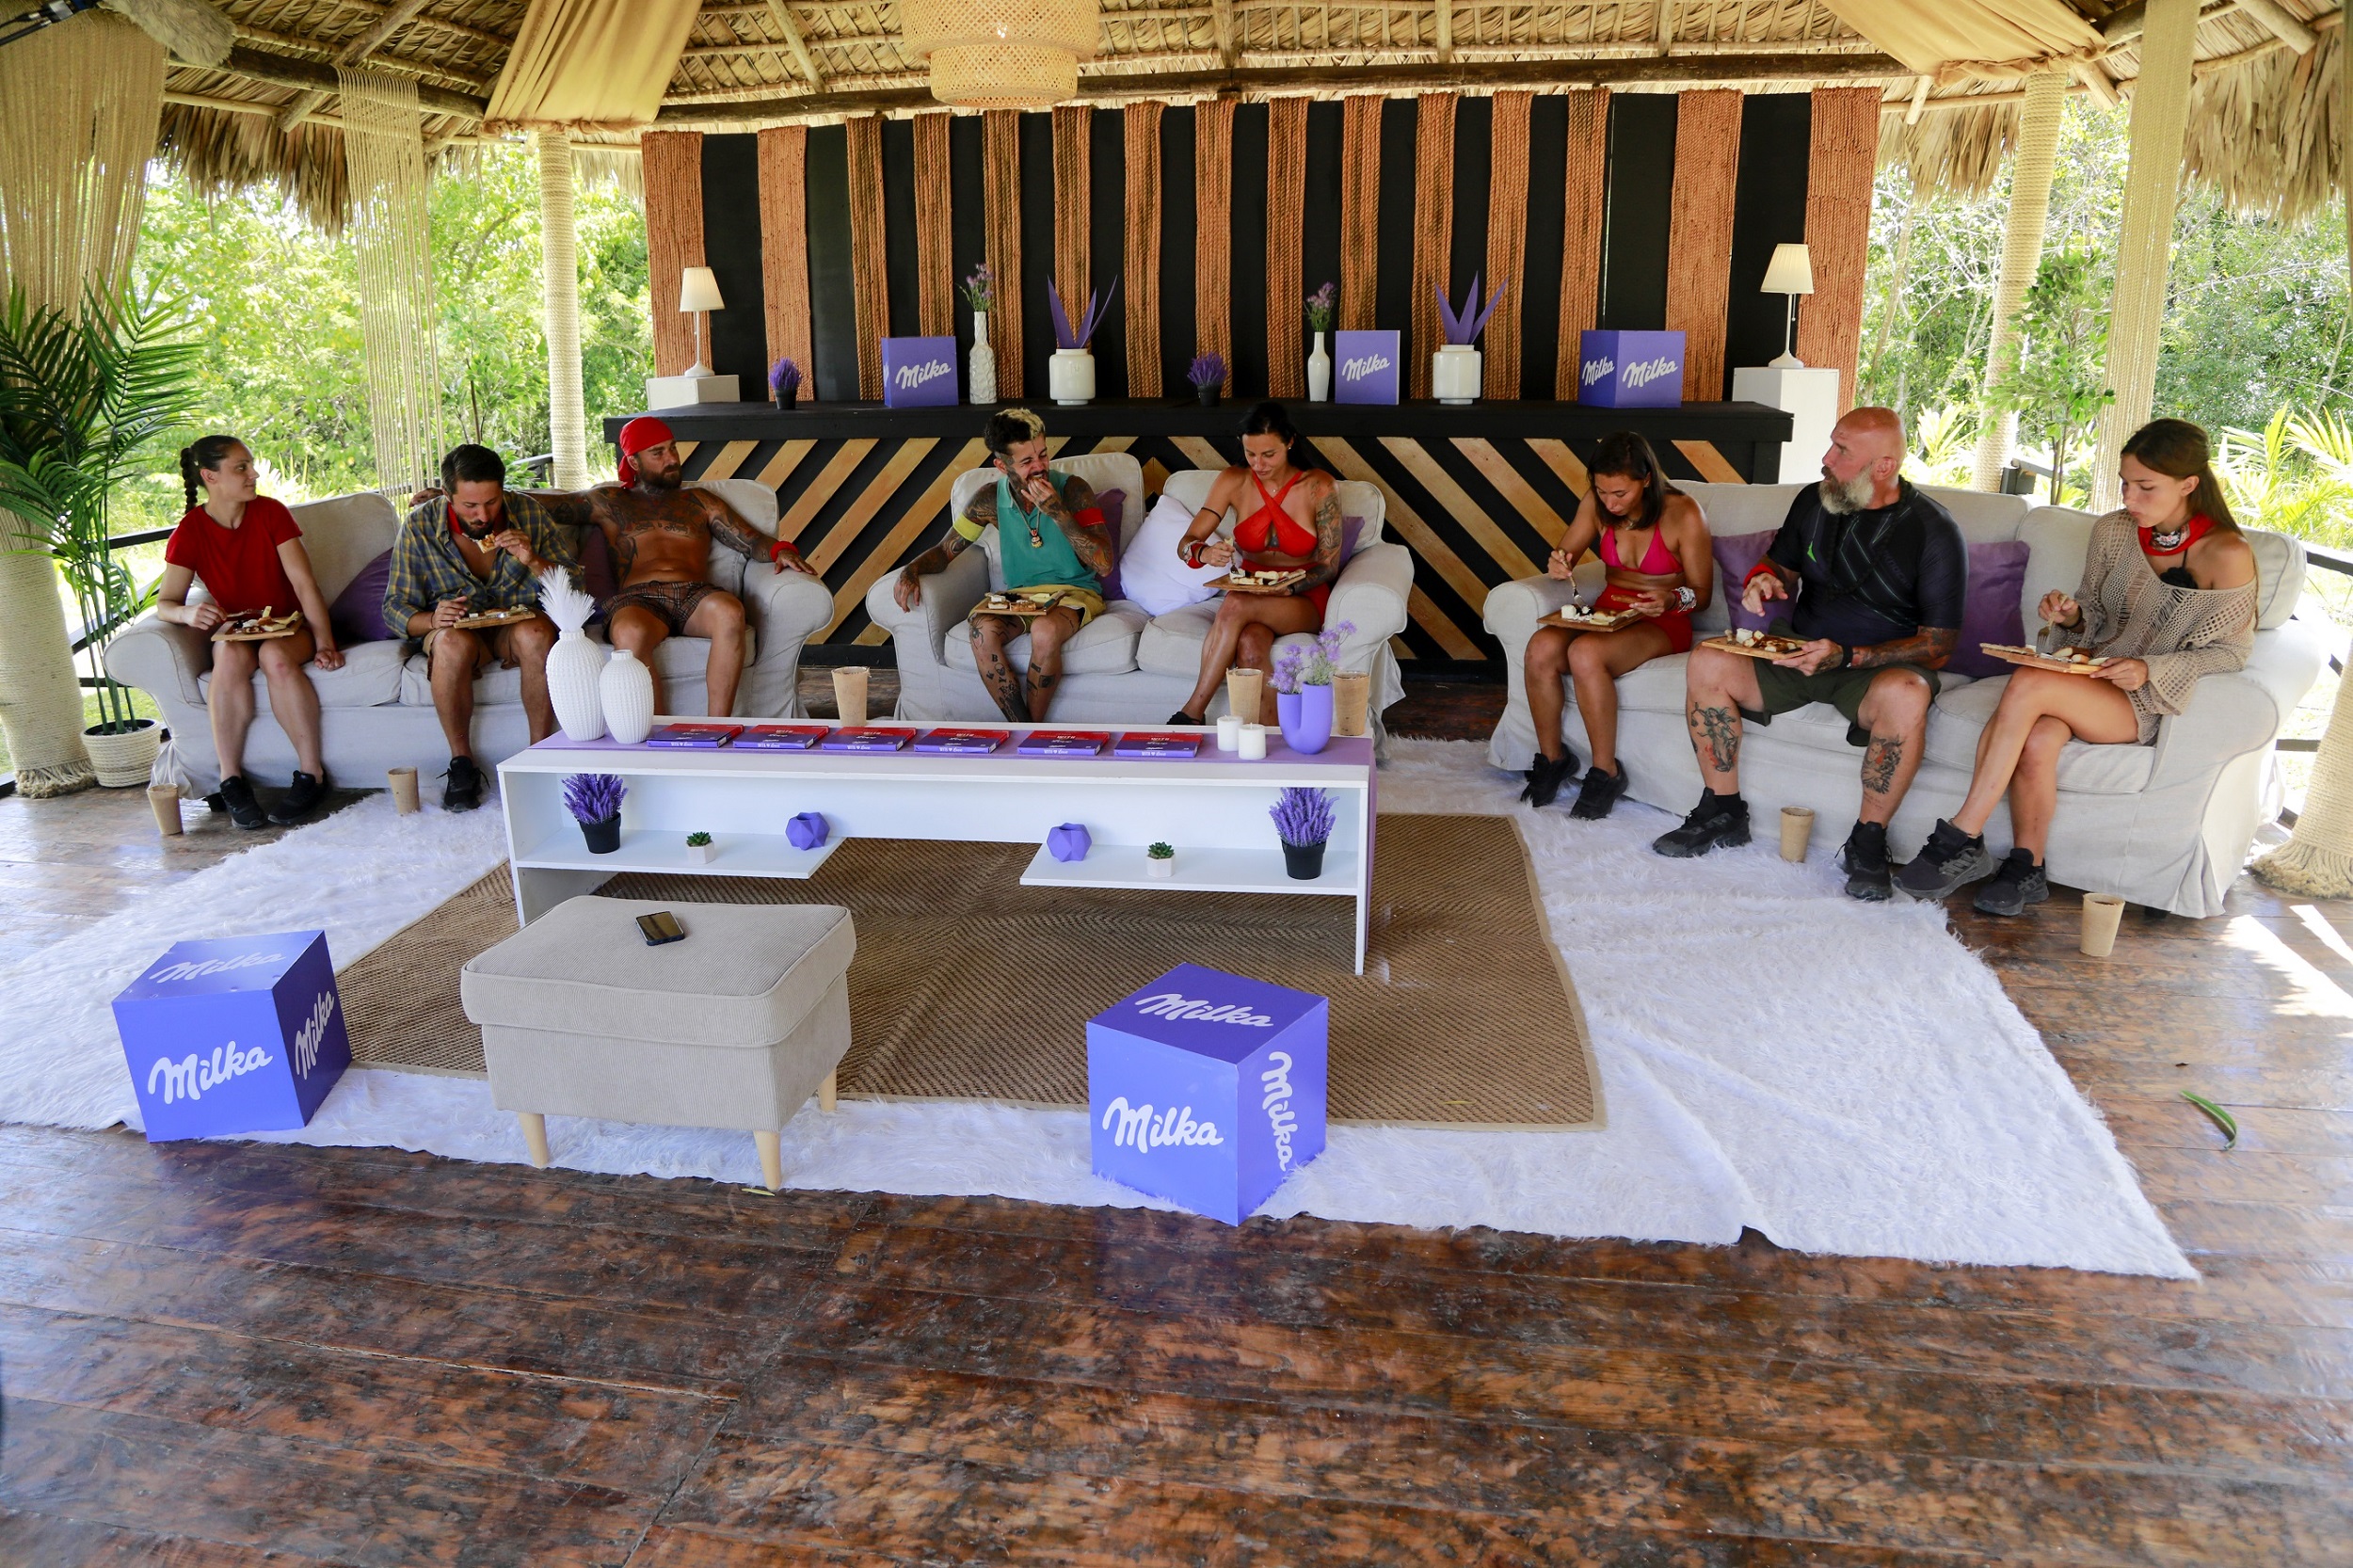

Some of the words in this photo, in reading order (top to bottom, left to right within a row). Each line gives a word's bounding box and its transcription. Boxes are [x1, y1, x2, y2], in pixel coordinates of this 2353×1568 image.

[895, 359, 952, 390] Milka
[1341, 353, 1391, 382] Milka
[1581, 356, 1615, 386] Milka
[1622, 356, 1678, 389] Milka
[149, 952, 286, 984] Milka
[1134, 993, 1274, 1027] Milka
[295, 990, 335, 1080] Milka
[147, 1040, 274, 1105] Milka
[1101, 1096, 1224, 1154] Milka
[1261, 1050, 1298, 1172] Milka
